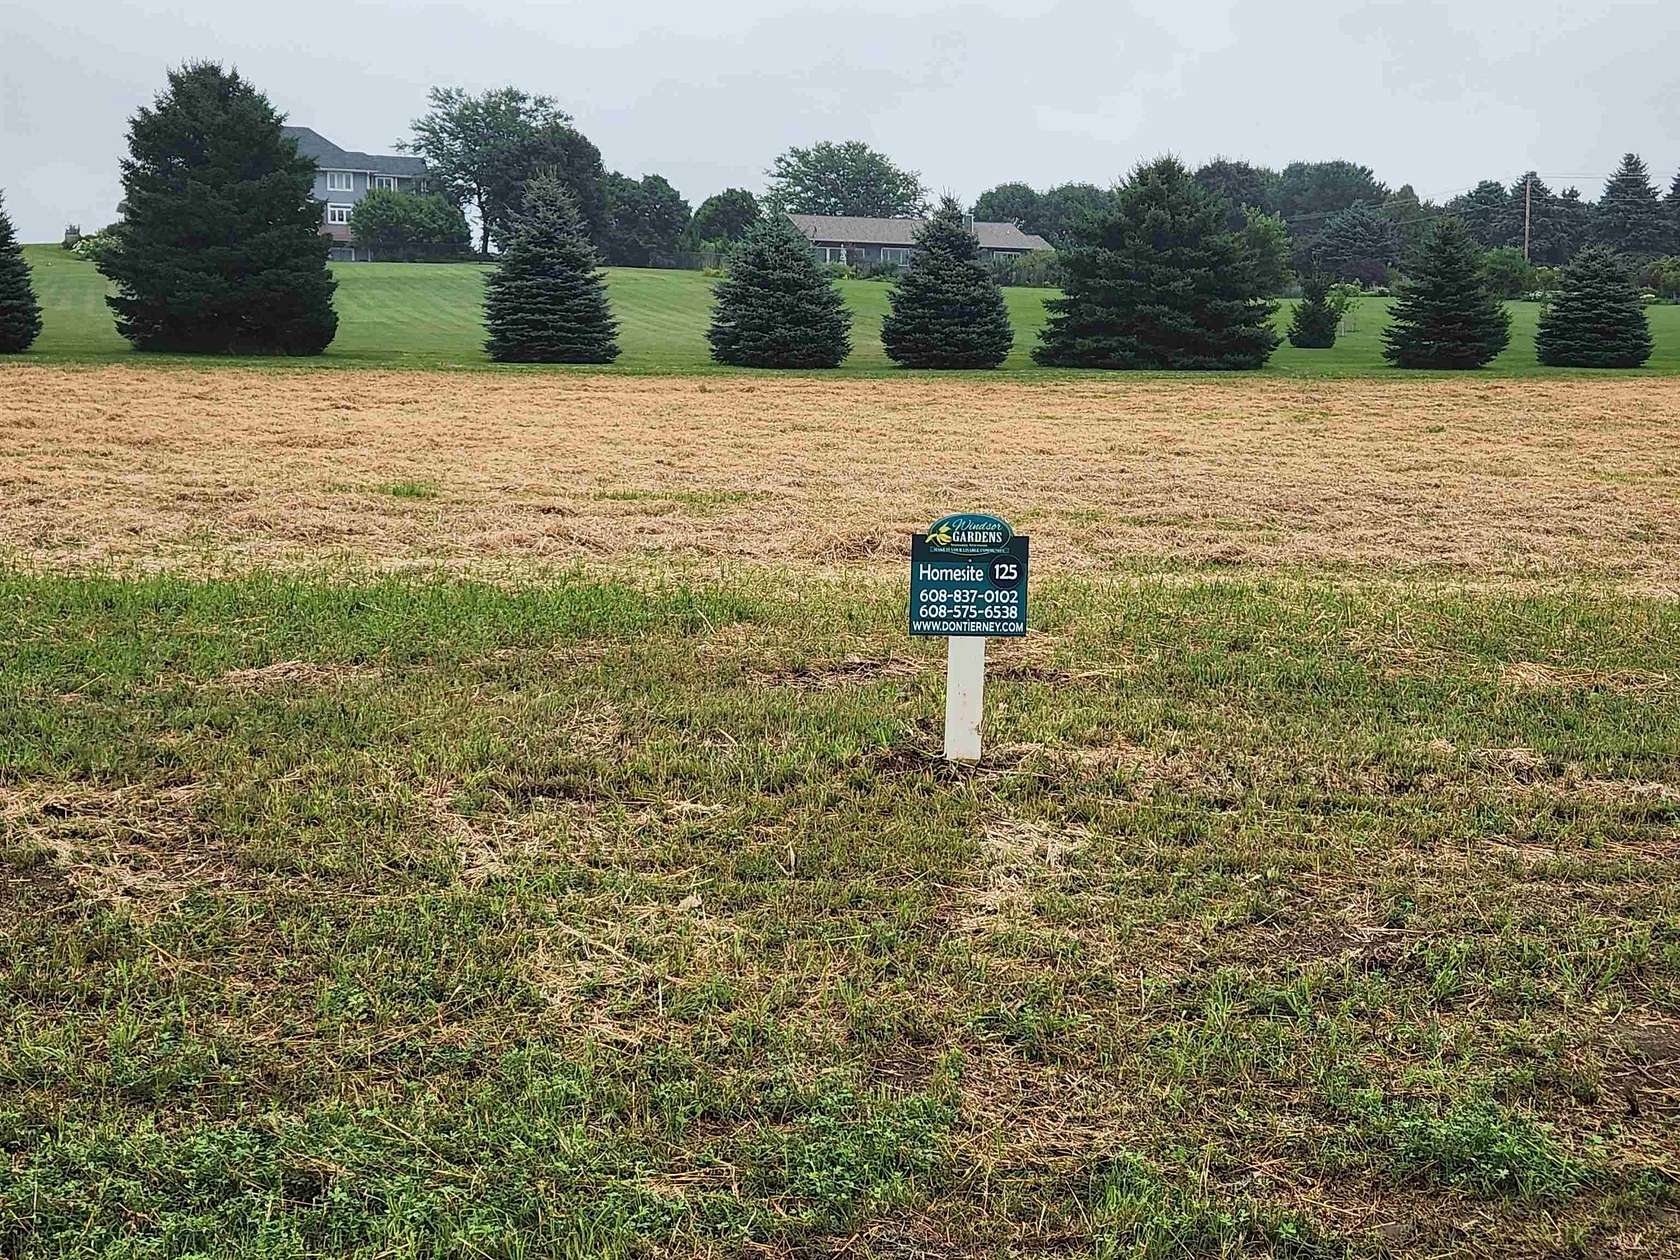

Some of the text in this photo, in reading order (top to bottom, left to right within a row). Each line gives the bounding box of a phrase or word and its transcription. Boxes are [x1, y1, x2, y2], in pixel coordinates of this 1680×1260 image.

[952, 519, 1003, 531] Windsor
[953, 532, 1003, 543] GARDENS
[919, 563, 1018, 582] Homesite 125
[920, 589, 1019, 603] 608-837-0102
[919, 605, 1018, 619] 608-575-6538
[912, 621, 1024, 632] WWW.DONTIERNEY.COM
